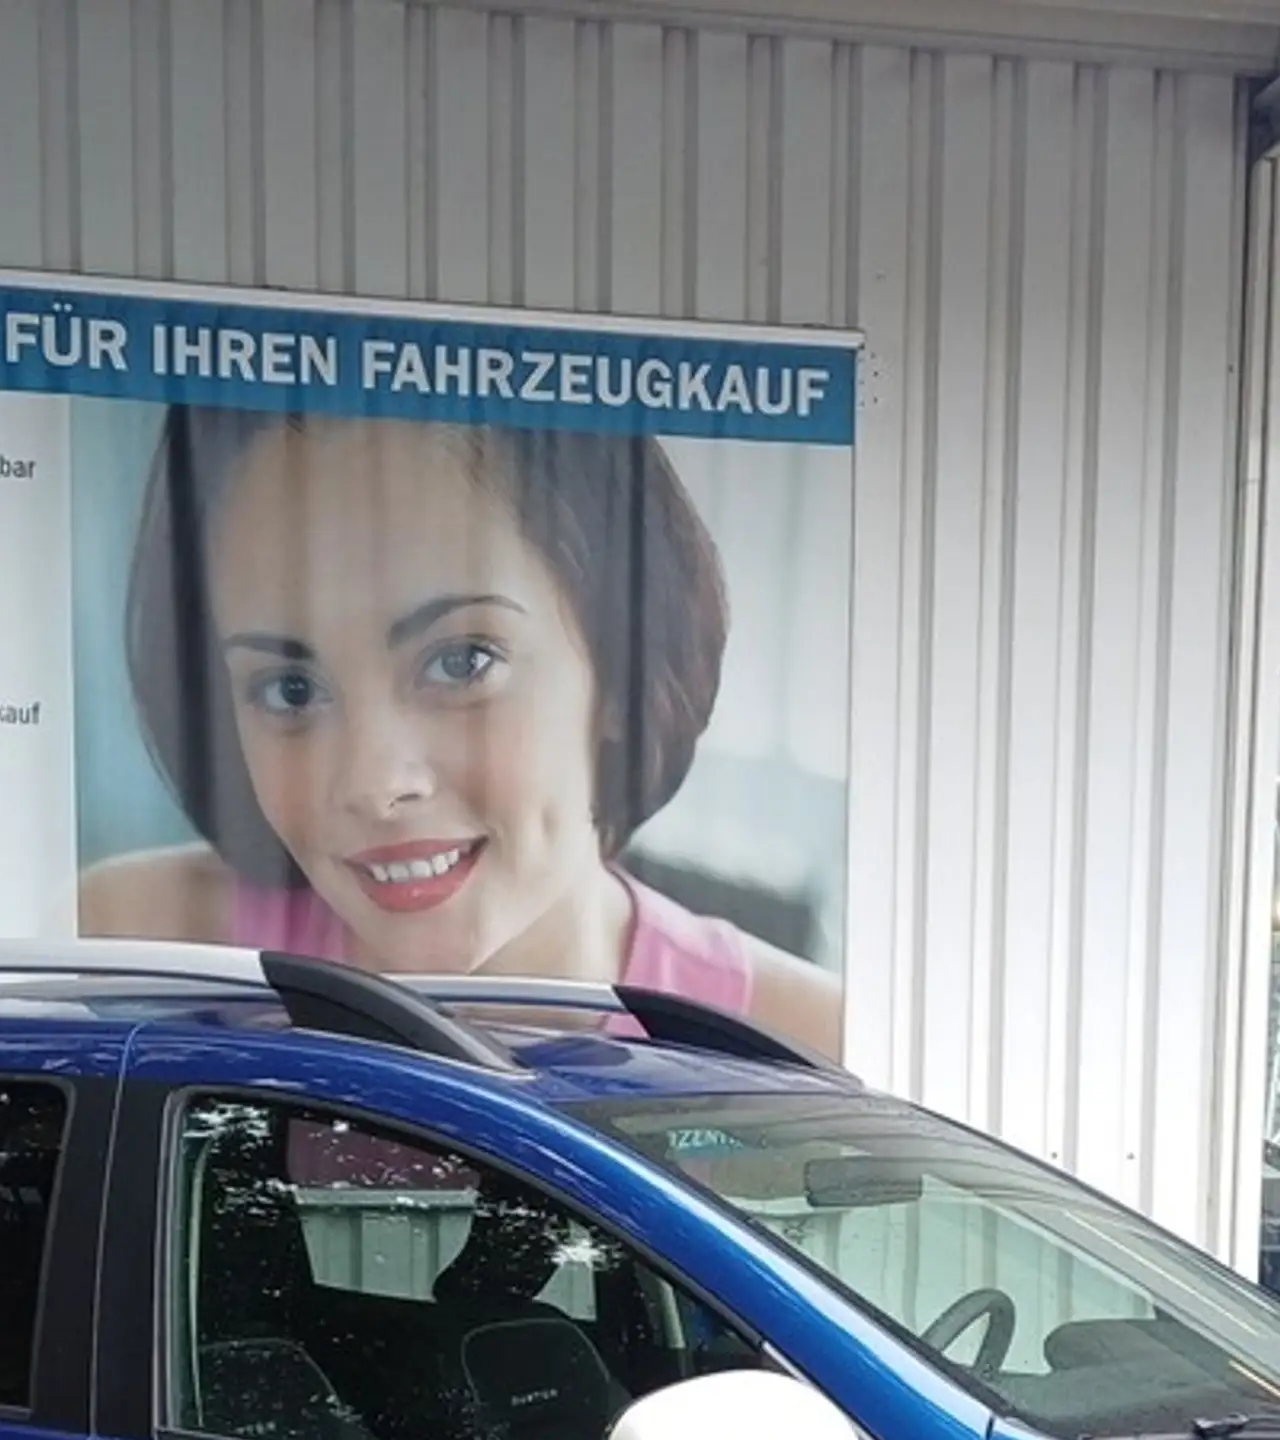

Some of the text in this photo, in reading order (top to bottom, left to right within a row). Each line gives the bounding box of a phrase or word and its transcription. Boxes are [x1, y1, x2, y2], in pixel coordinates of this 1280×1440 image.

[5, 302, 128, 372] FÜR
[152, 324, 337, 387] IHREN
[361, 340, 830, 419] FAHRZEUGKAUF
